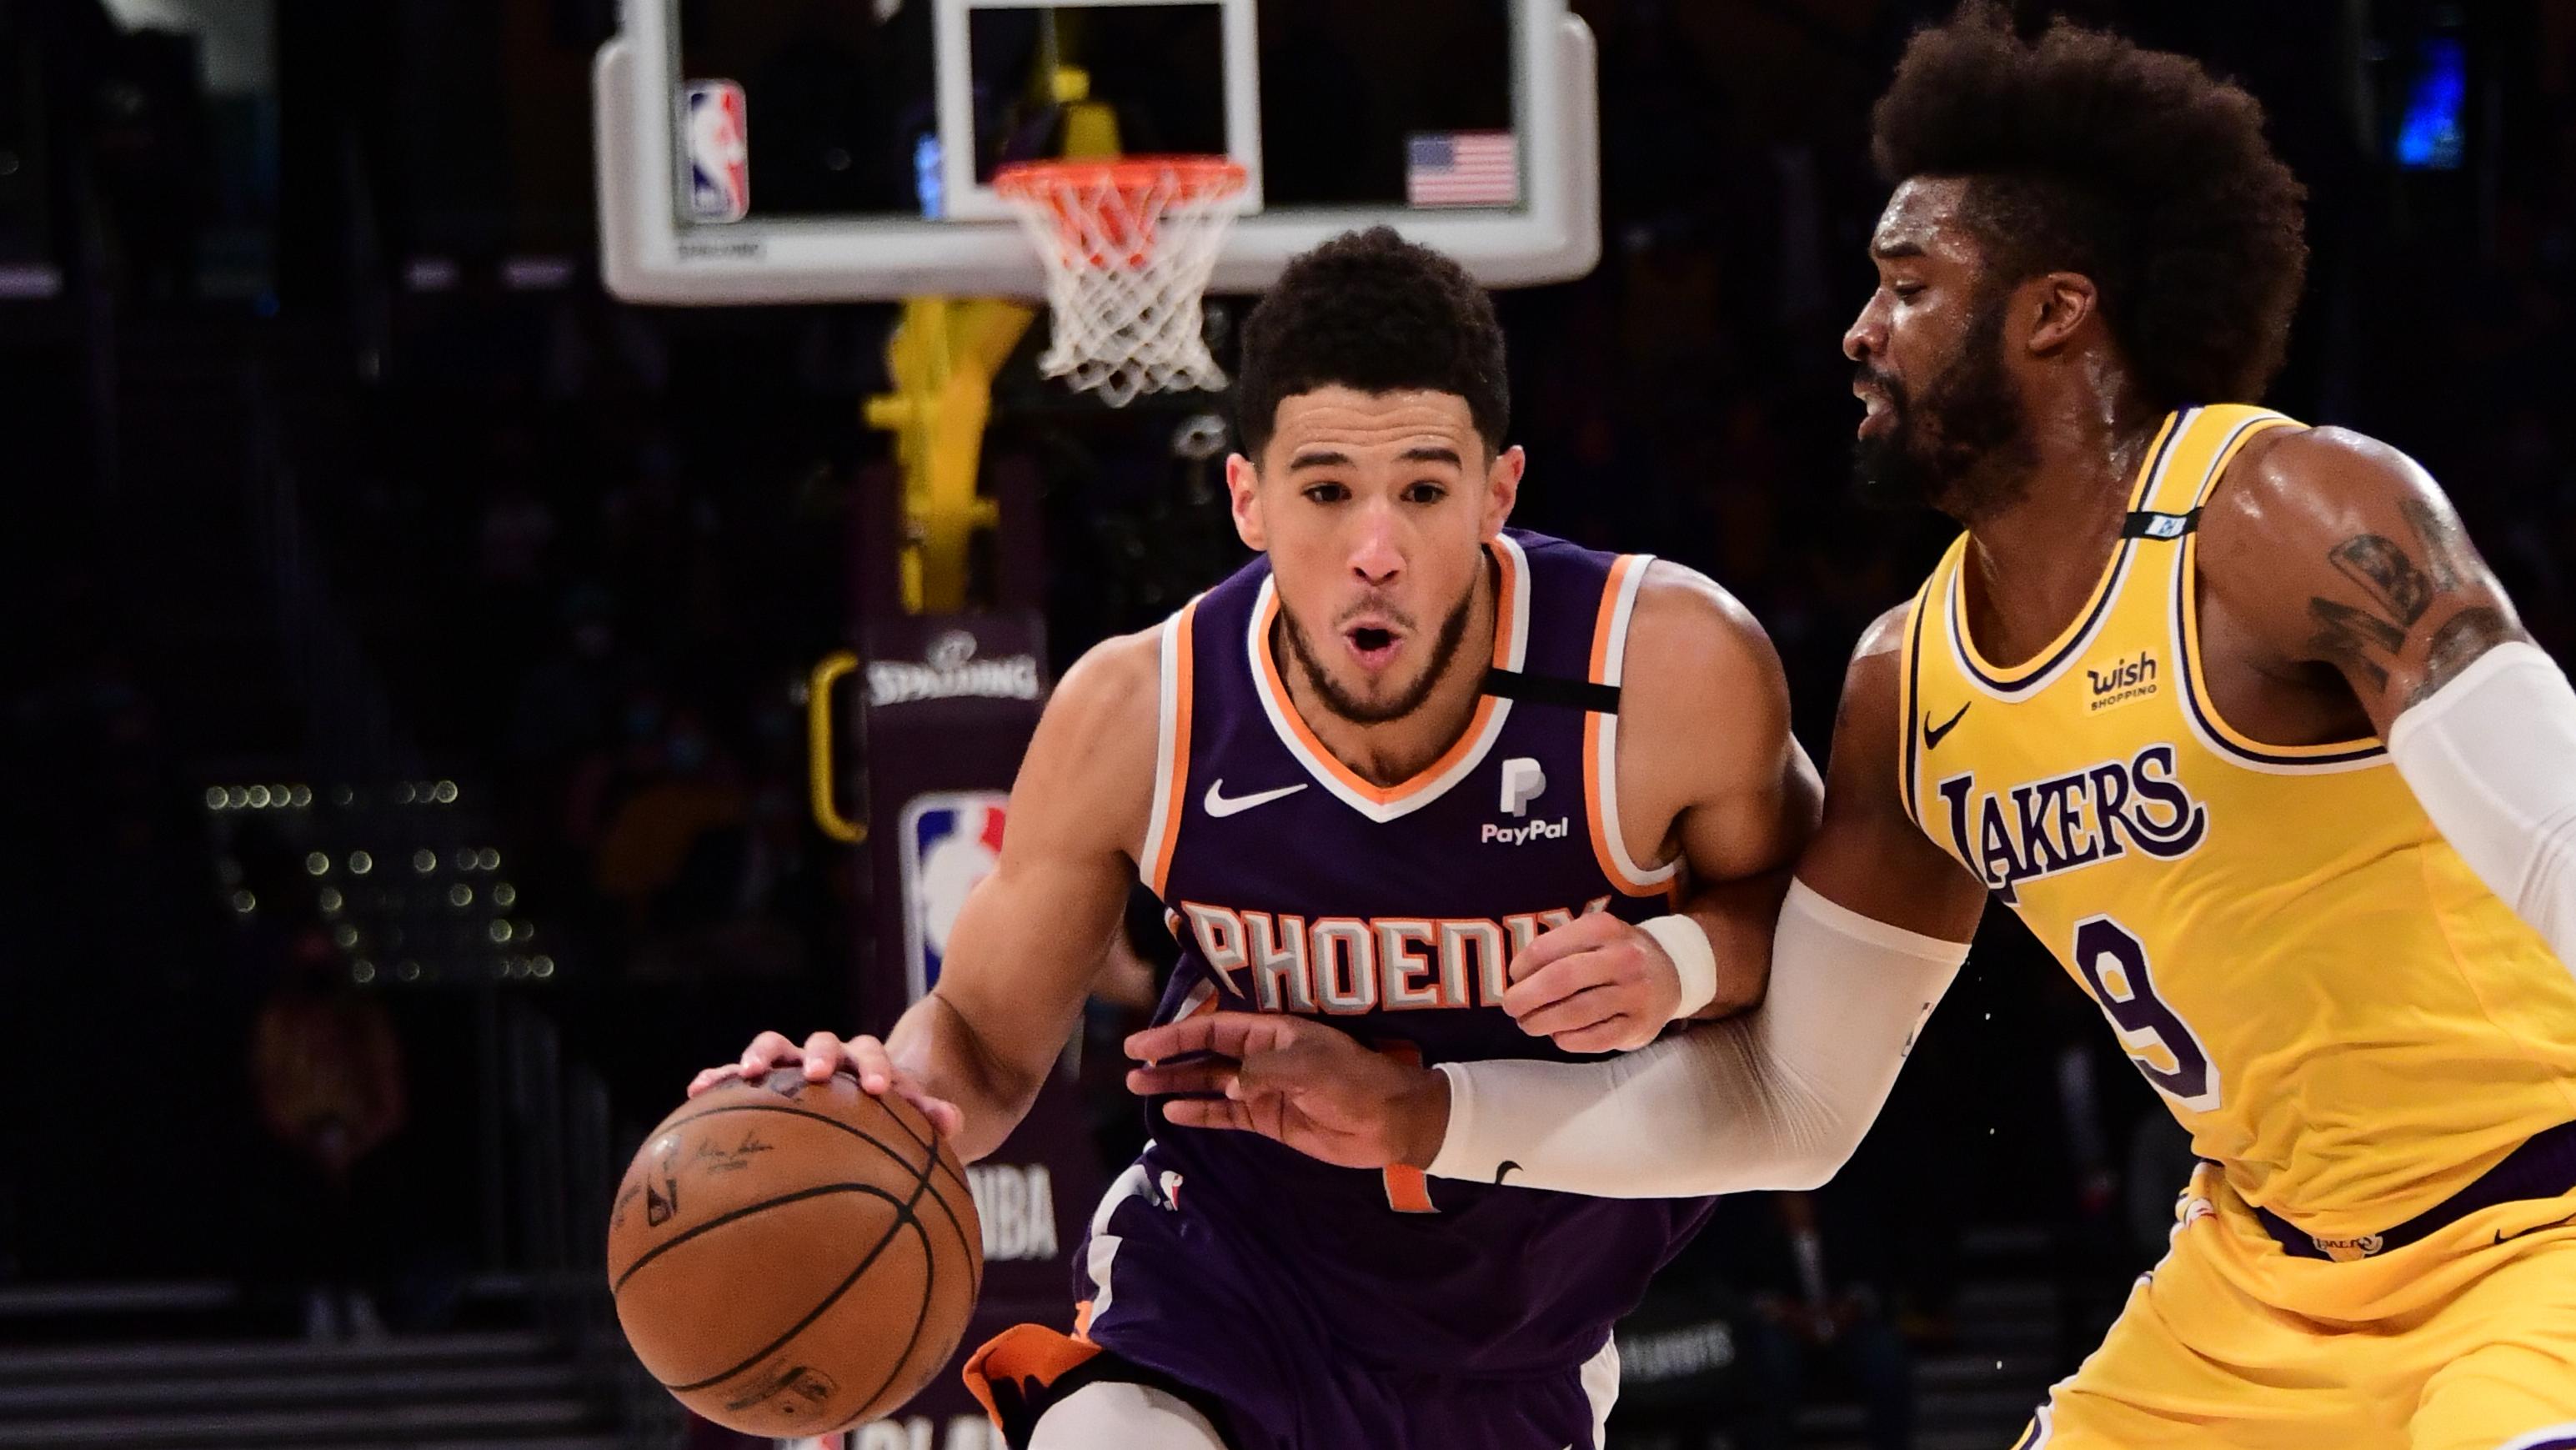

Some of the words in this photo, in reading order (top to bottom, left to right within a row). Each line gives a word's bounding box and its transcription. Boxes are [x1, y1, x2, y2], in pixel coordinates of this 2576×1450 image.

[2087, 650, 2157, 695] wish
[2091, 685, 2158, 711] SHOPPING
[1481, 816, 1568, 845] PayPal
[1938, 743, 2208, 906] LAKERS
[1181, 895, 1611, 1015] PHOEN
[2073, 913, 2221, 1113] 9
